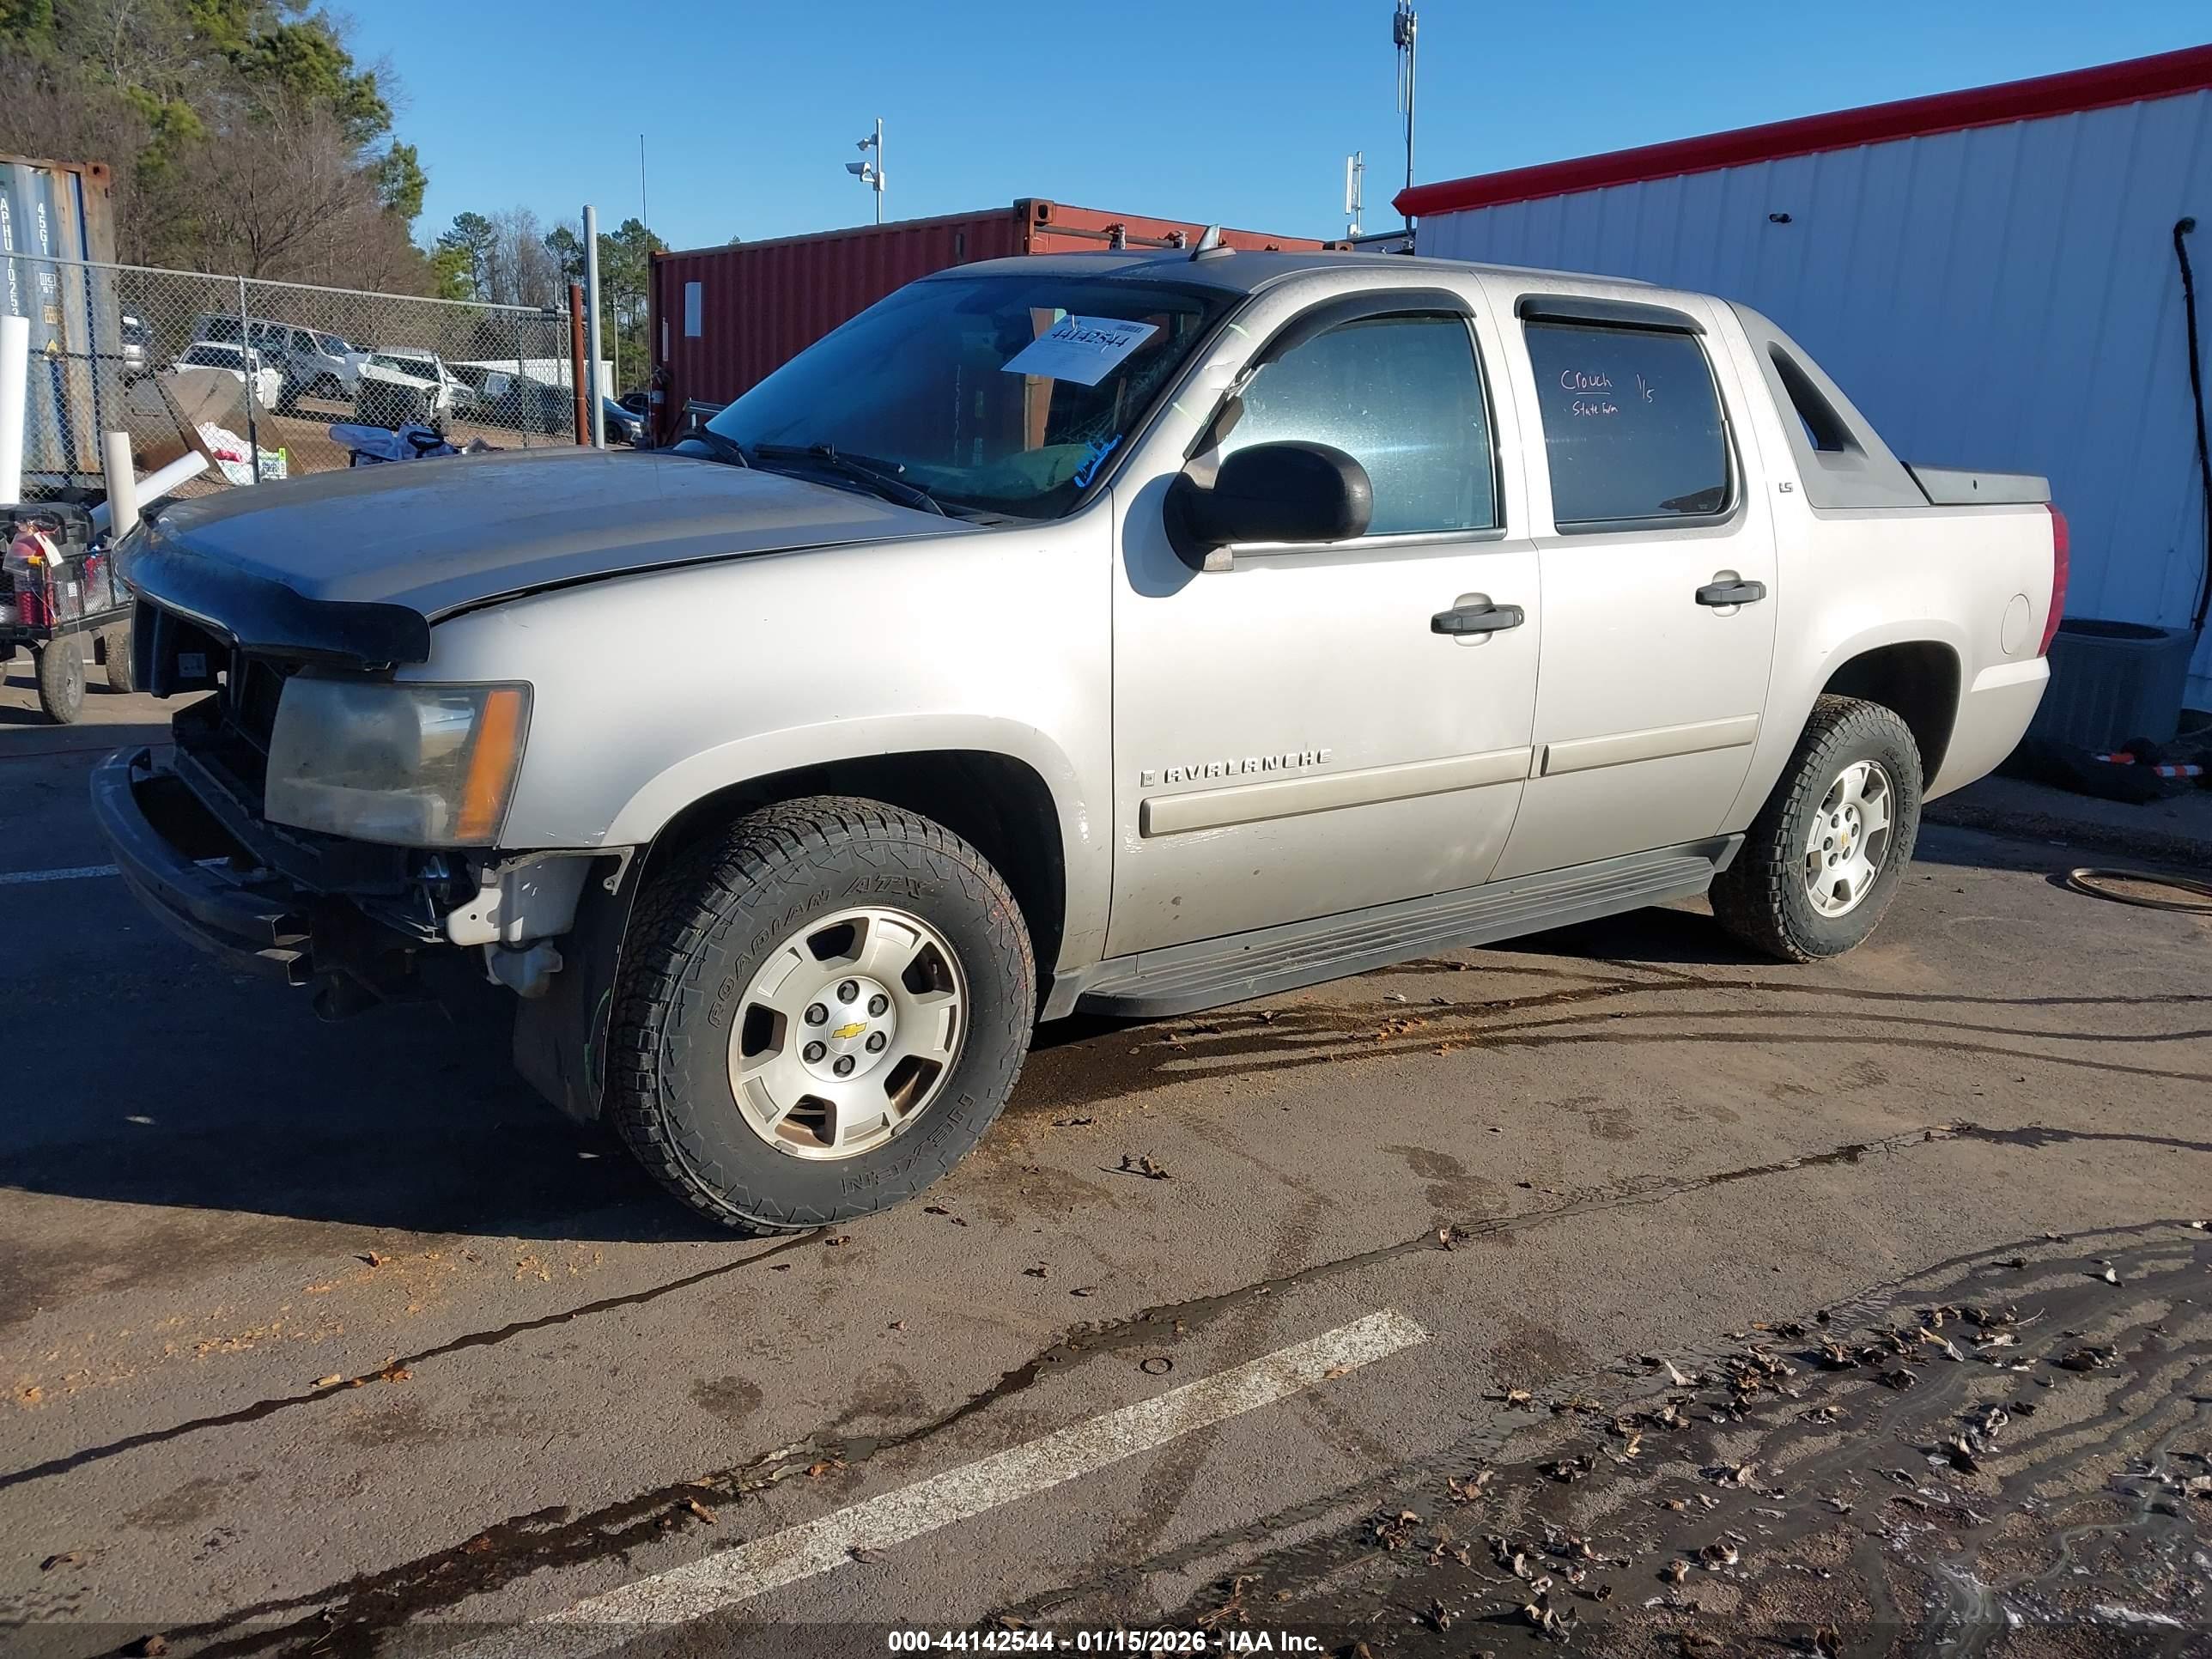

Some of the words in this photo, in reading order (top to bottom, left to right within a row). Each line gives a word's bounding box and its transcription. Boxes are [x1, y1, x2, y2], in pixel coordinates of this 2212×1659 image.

[37, 203, 47, 255] 45G1
[1560, 370, 1613, 390] Crouch
[1572, 400, 1599, 416] State
[1779, 482, 1793, 493] LS
[1164, 749, 1333, 784] AVALANCHE
[708, 888, 831, 1028] ROADIAN
